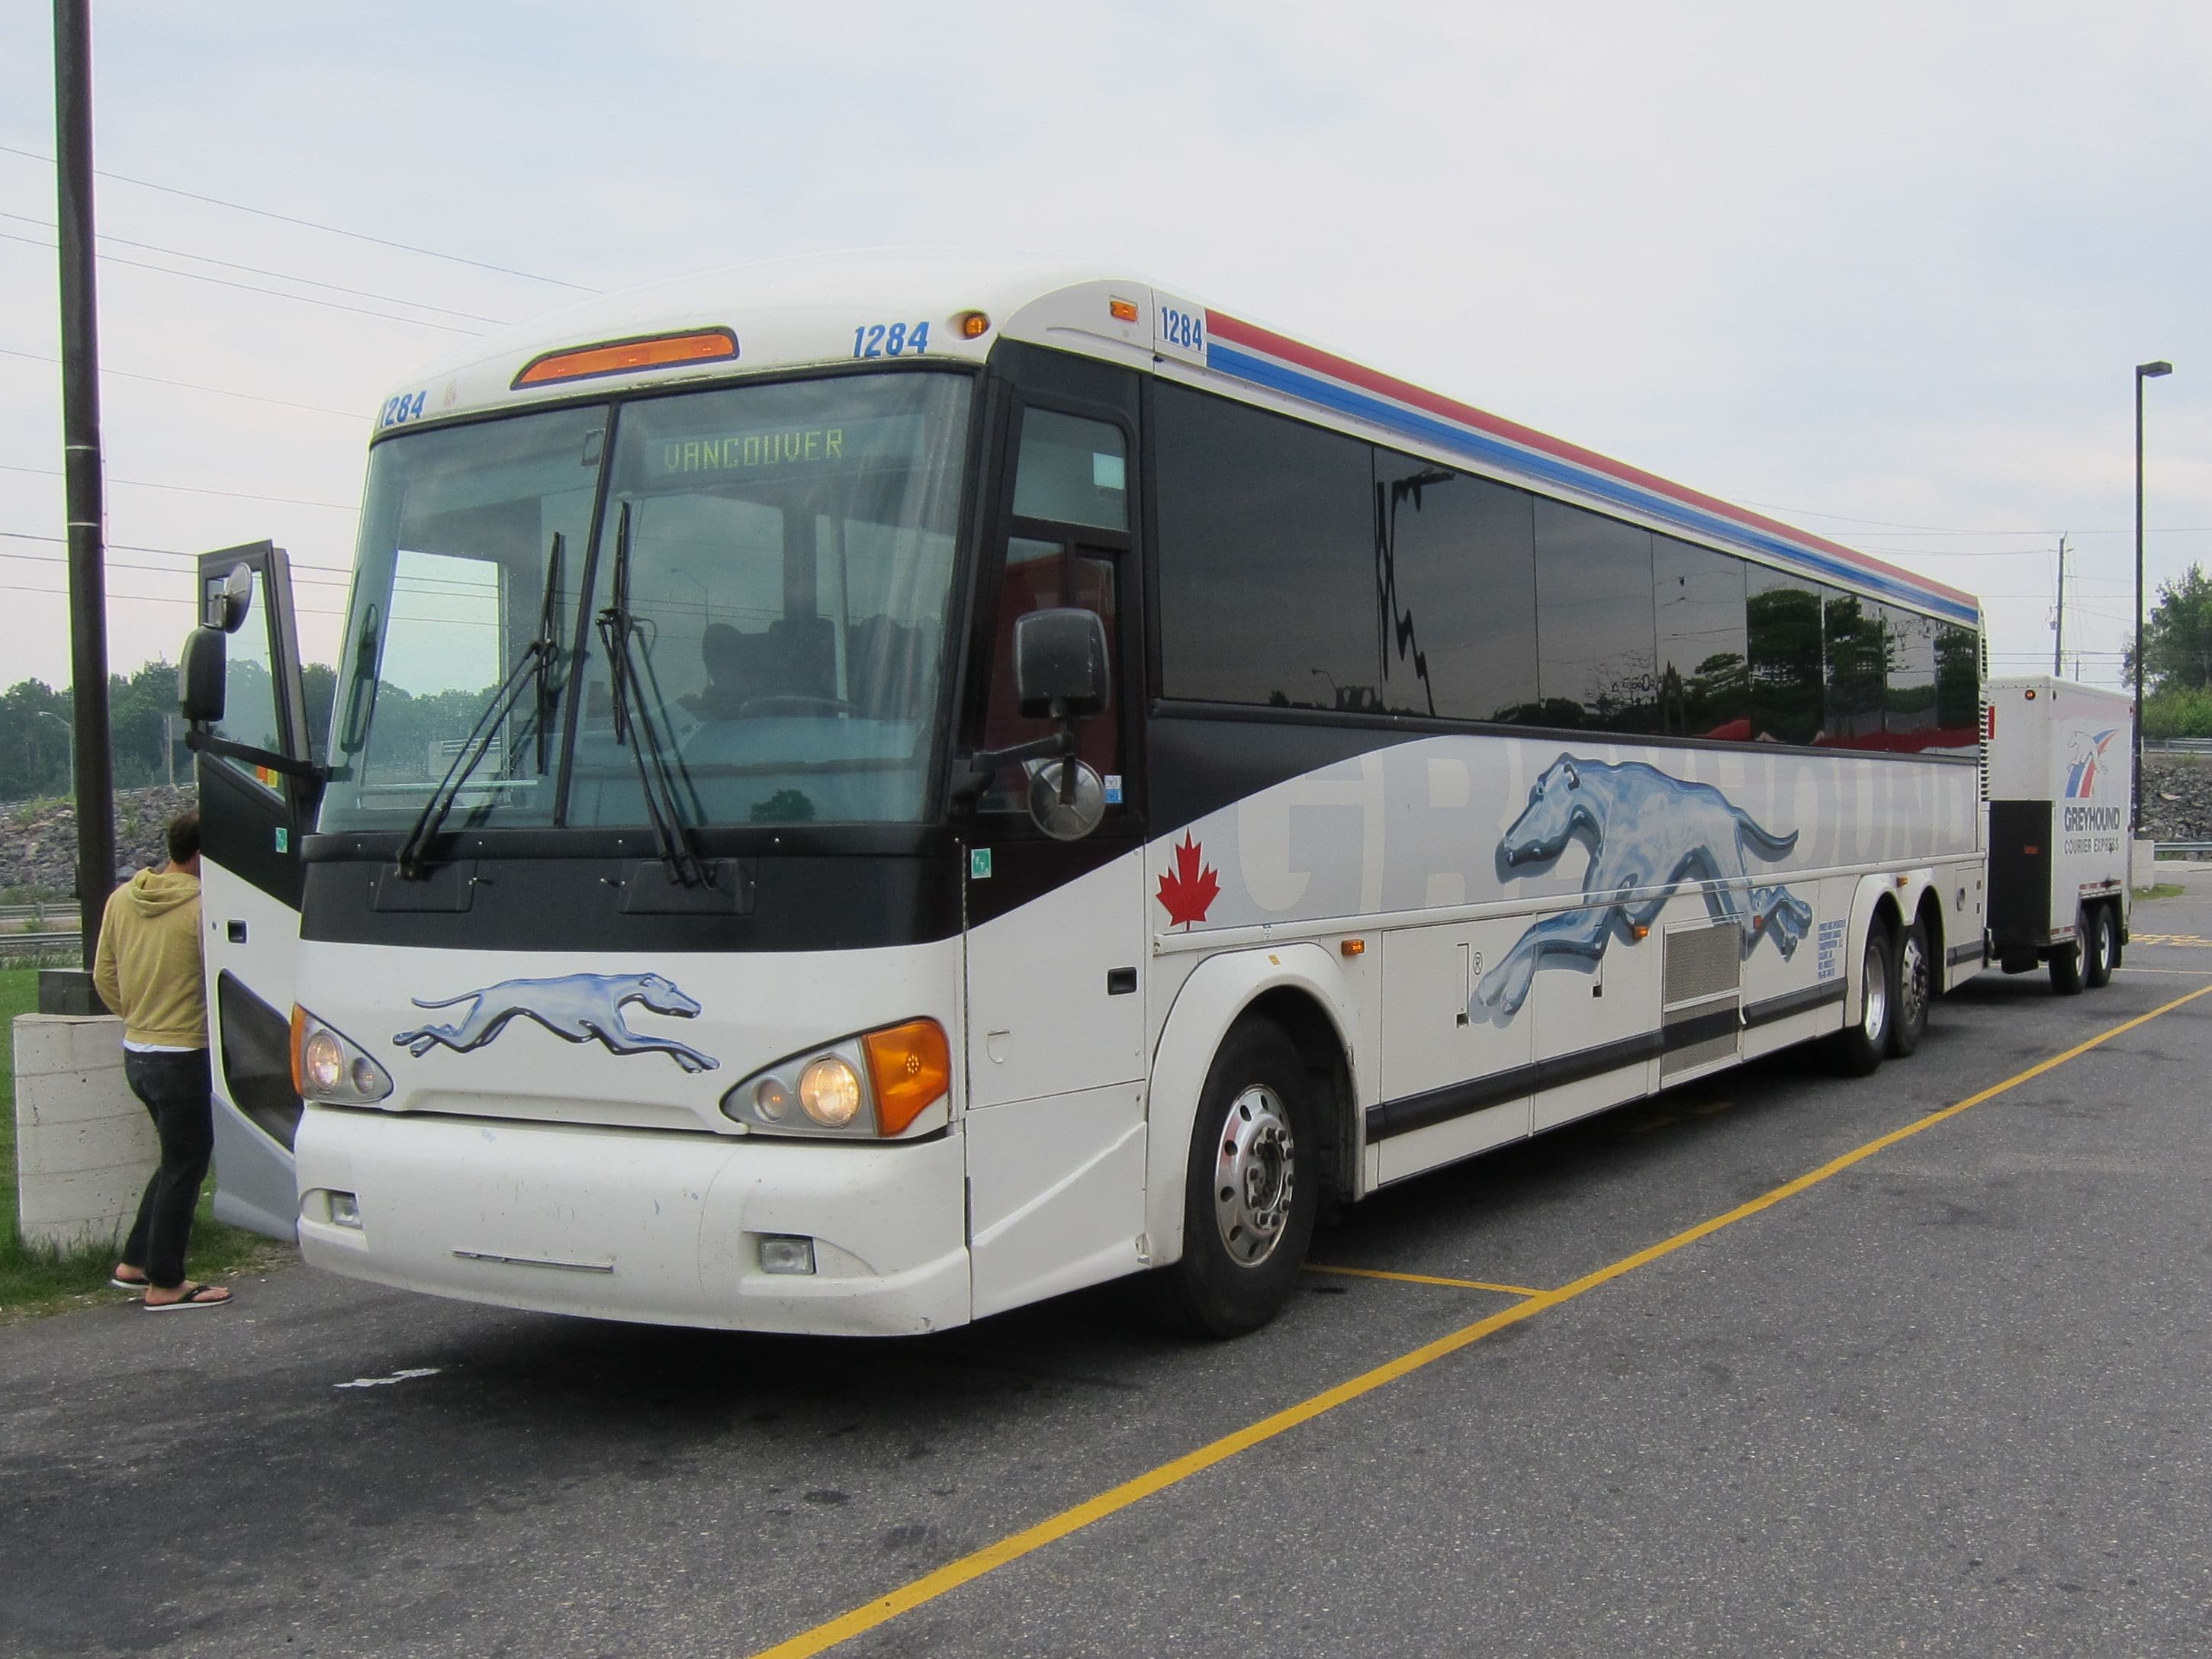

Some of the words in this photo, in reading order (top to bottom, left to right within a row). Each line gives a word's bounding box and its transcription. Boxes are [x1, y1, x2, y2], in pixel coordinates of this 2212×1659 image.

[854, 320, 929, 358] 1284
[1162, 307, 1203, 351] 1284
[380, 391, 427, 428] 1284
[664, 427, 843, 474] VANCOUVER
[1170, 735, 1976, 932] GRHOUND
[2064, 805, 2120, 832] GREYHOUND
